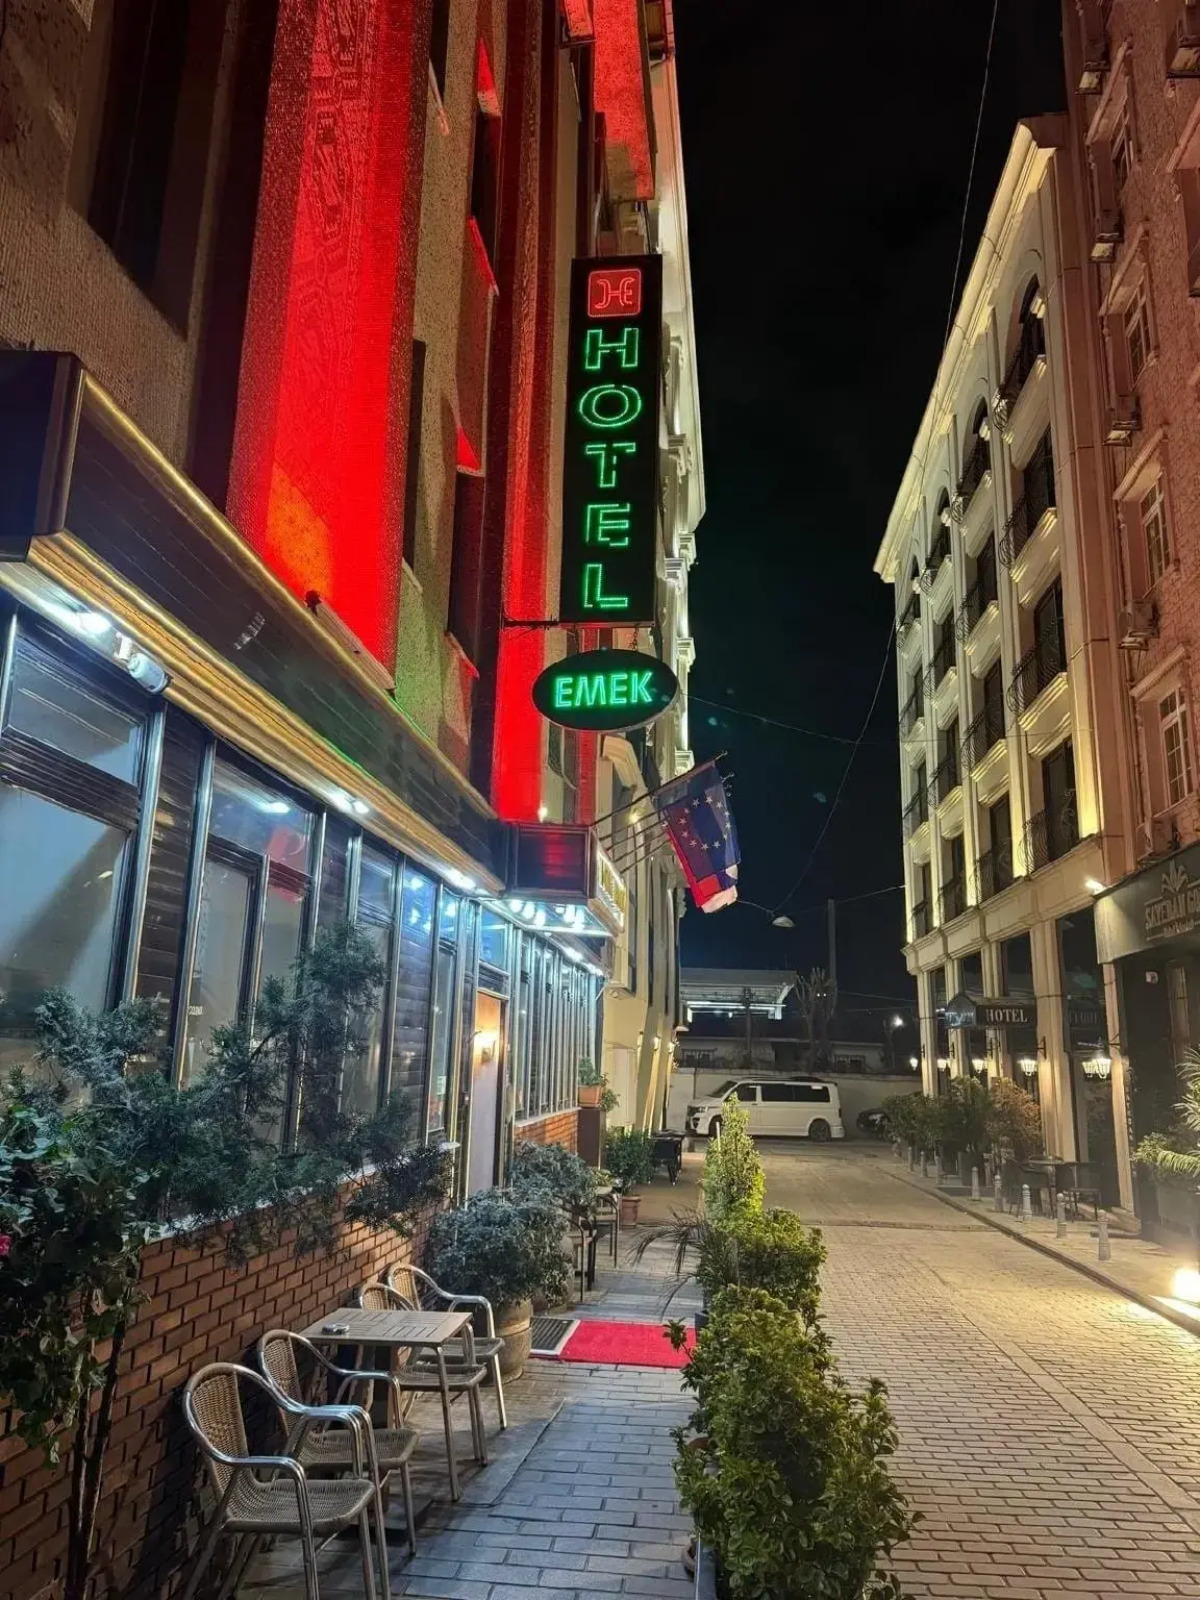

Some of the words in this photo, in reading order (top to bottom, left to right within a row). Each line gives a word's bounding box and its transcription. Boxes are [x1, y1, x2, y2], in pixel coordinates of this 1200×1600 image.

[579, 327, 642, 608] HOTEL
[555, 671, 653, 708] EMEK
[985, 1008, 1028, 1023] HOTEL
